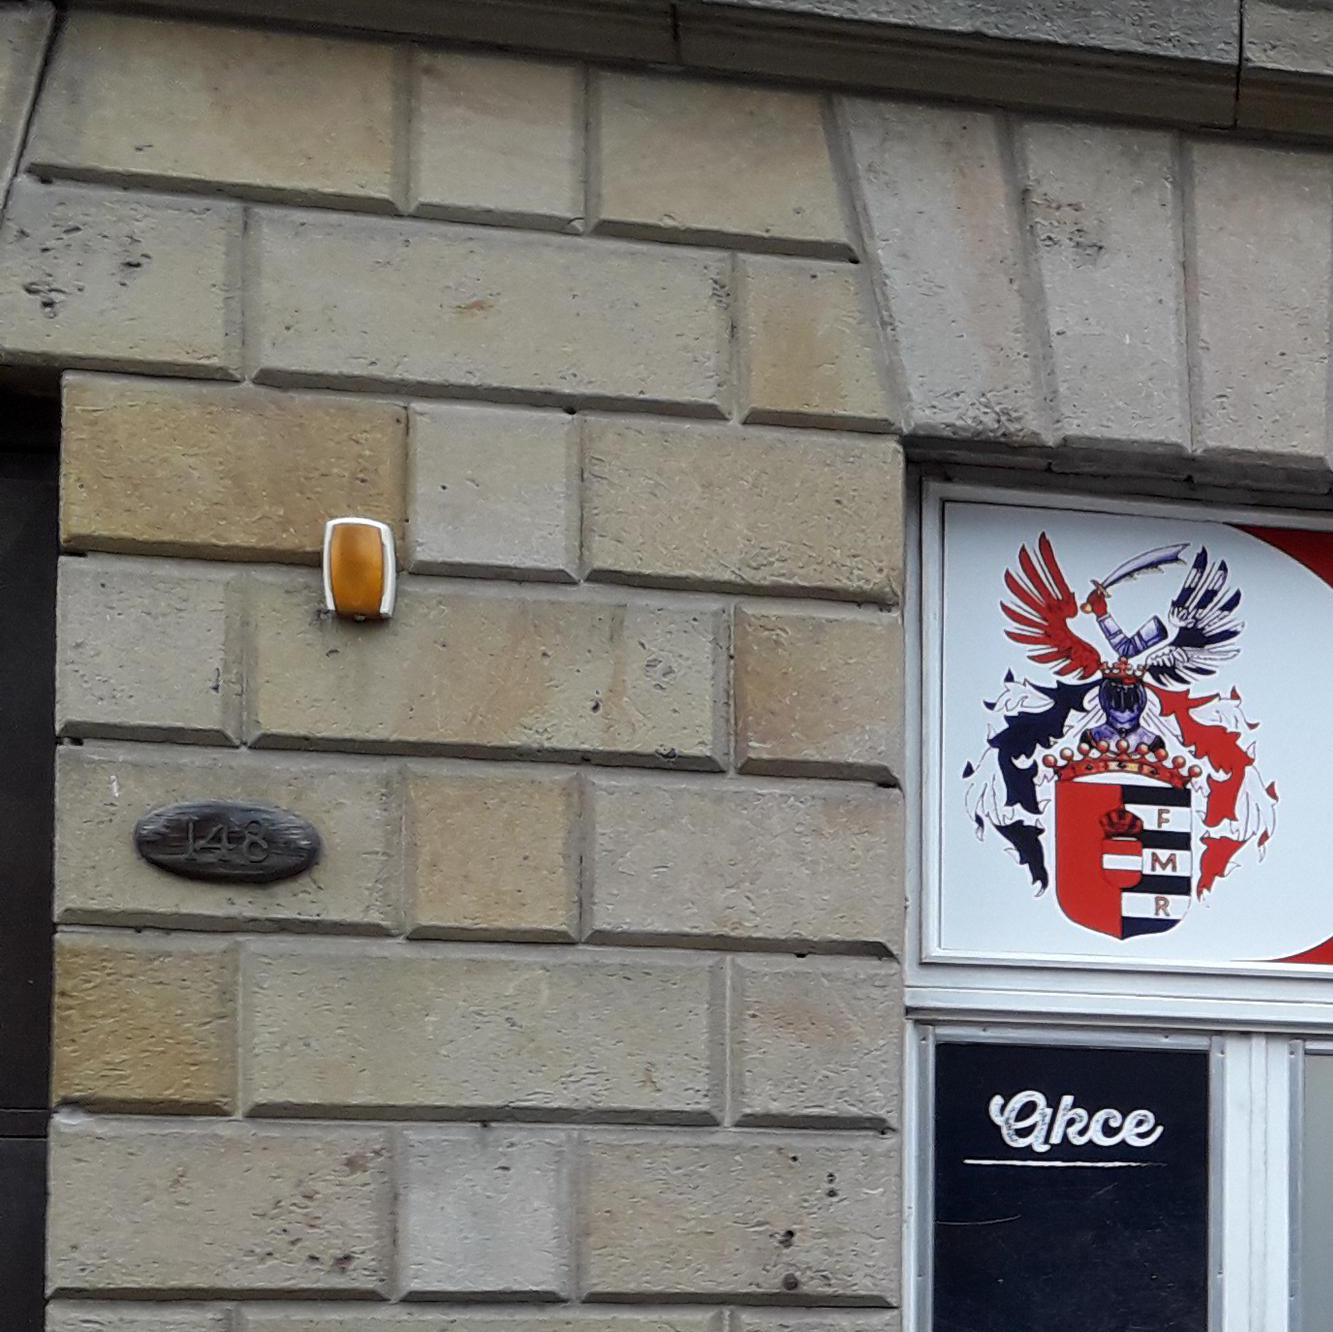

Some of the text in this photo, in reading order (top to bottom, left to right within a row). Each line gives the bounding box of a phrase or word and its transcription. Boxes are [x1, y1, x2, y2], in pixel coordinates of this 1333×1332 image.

[1156, 807, 1172, 830] F
[184, 819, 270, 865] 148
[1150, 850, 1178, 873] M
[1154, 895, 1171, 918] R
[988, 1089, 1165, 1154] Akce
